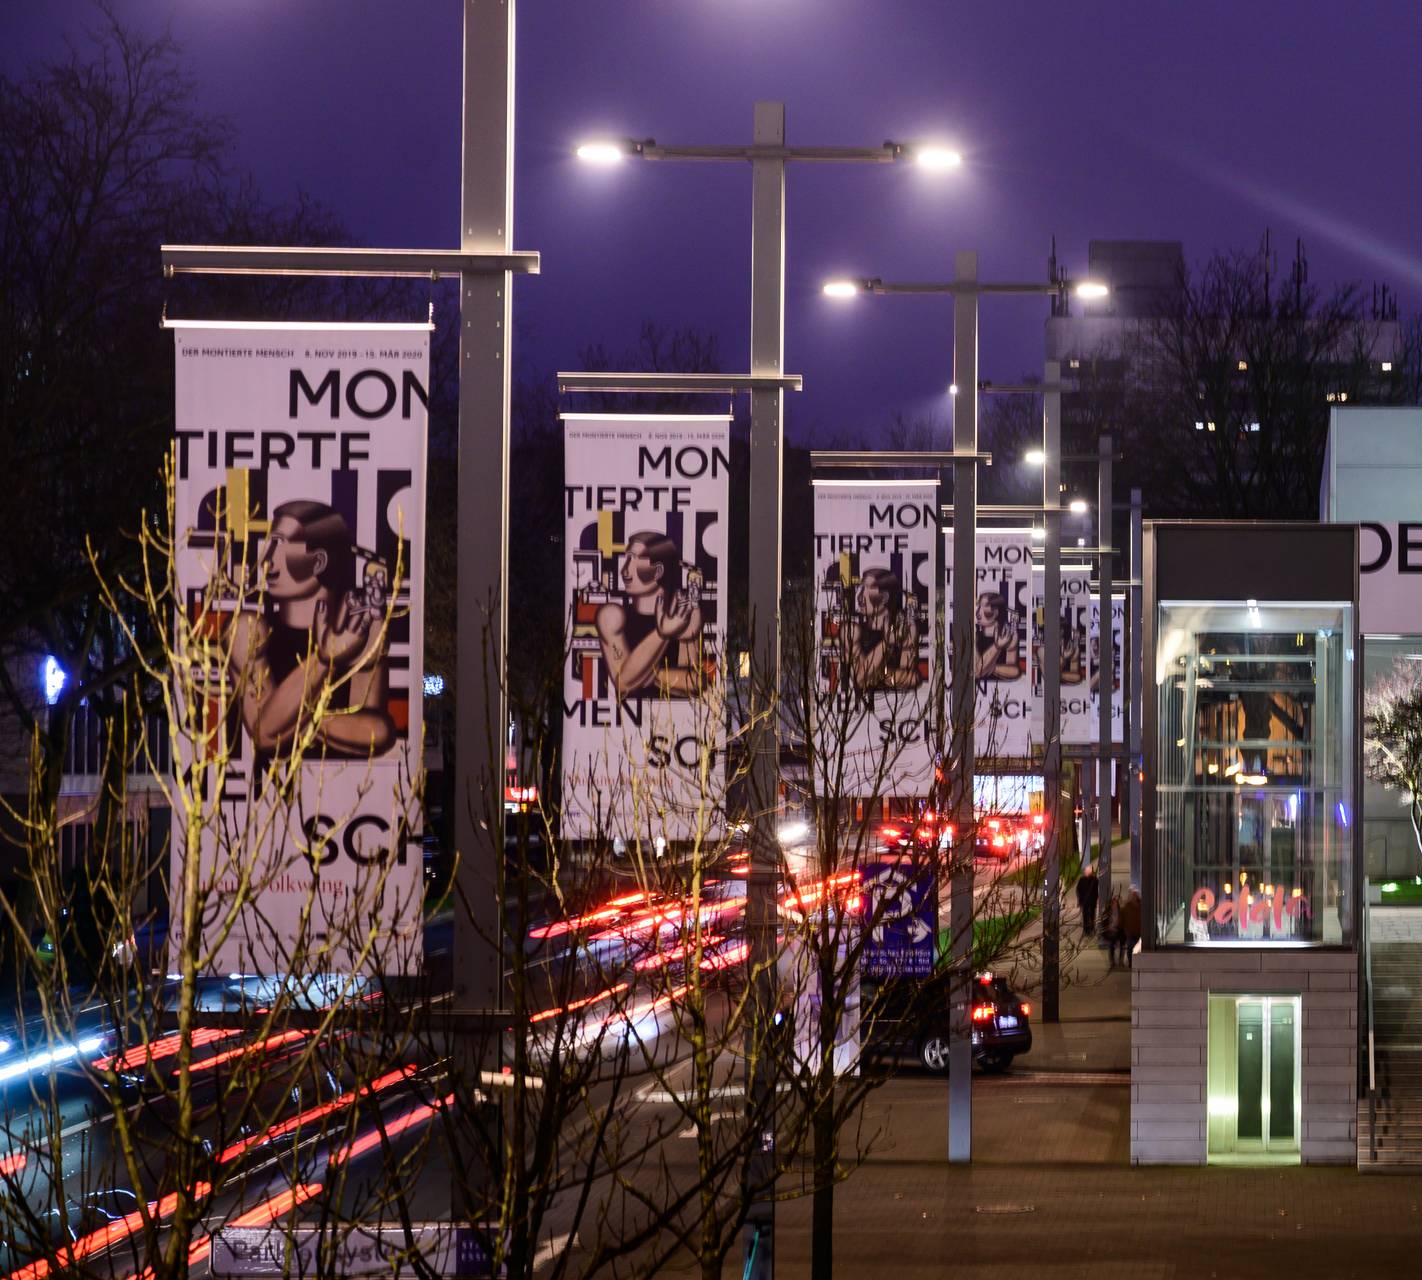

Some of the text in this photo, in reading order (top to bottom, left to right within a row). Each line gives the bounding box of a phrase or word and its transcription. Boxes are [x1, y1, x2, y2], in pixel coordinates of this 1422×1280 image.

[182, 347, 199, 358] DER
[201, 347, 253, 359] MONTIERTE
[255, 348, 295, 359] MENSCH
[314, 349, 336, 360] NOV
[401, 350, 424, 361] 2020
